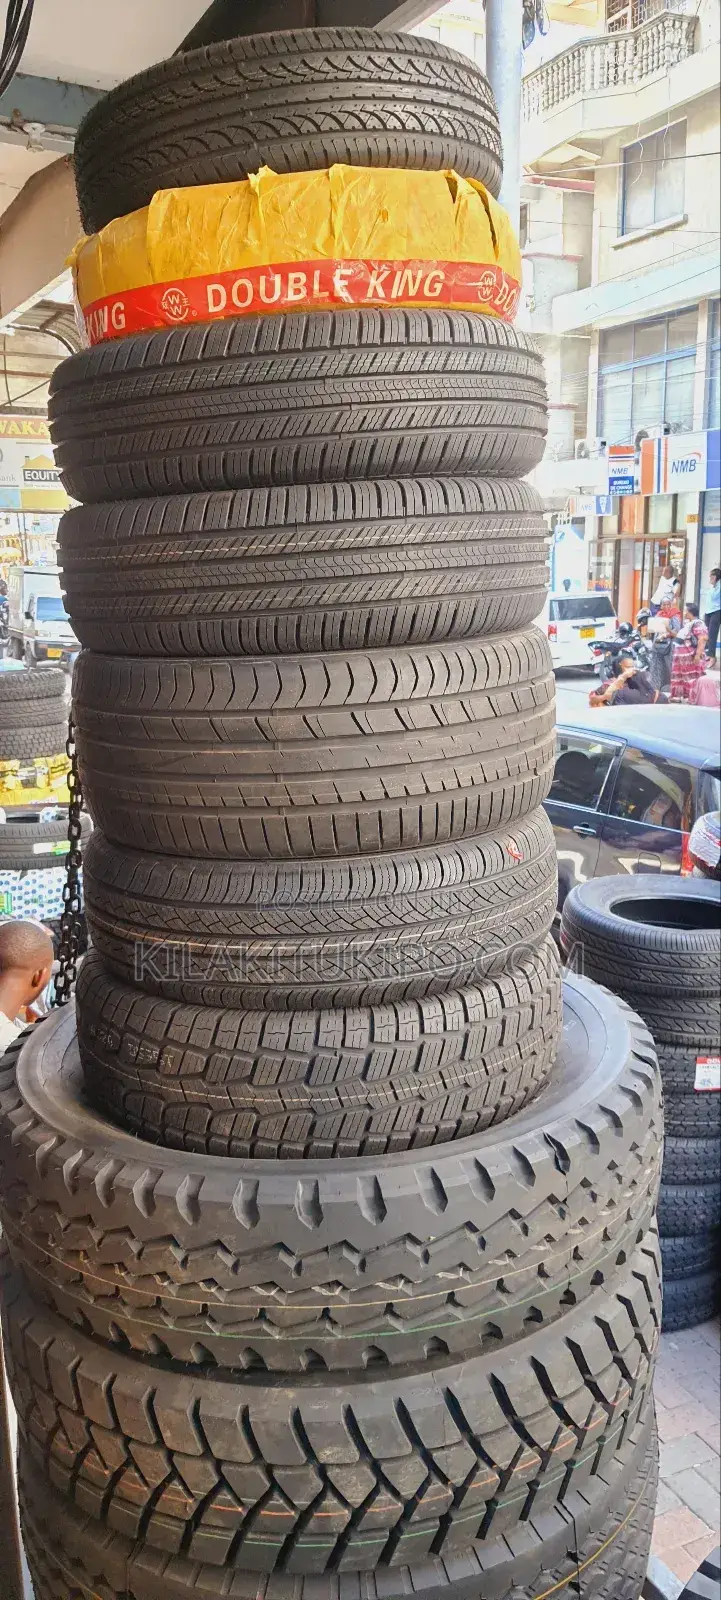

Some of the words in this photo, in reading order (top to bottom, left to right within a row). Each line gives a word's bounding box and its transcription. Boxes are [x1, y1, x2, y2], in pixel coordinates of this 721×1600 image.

[207, 268, 352, 313] DOUBLE
[367, 269, 445, 299] KING
[87, 301, 126, 347] KING
[672, 459, 697, 473] NMB
